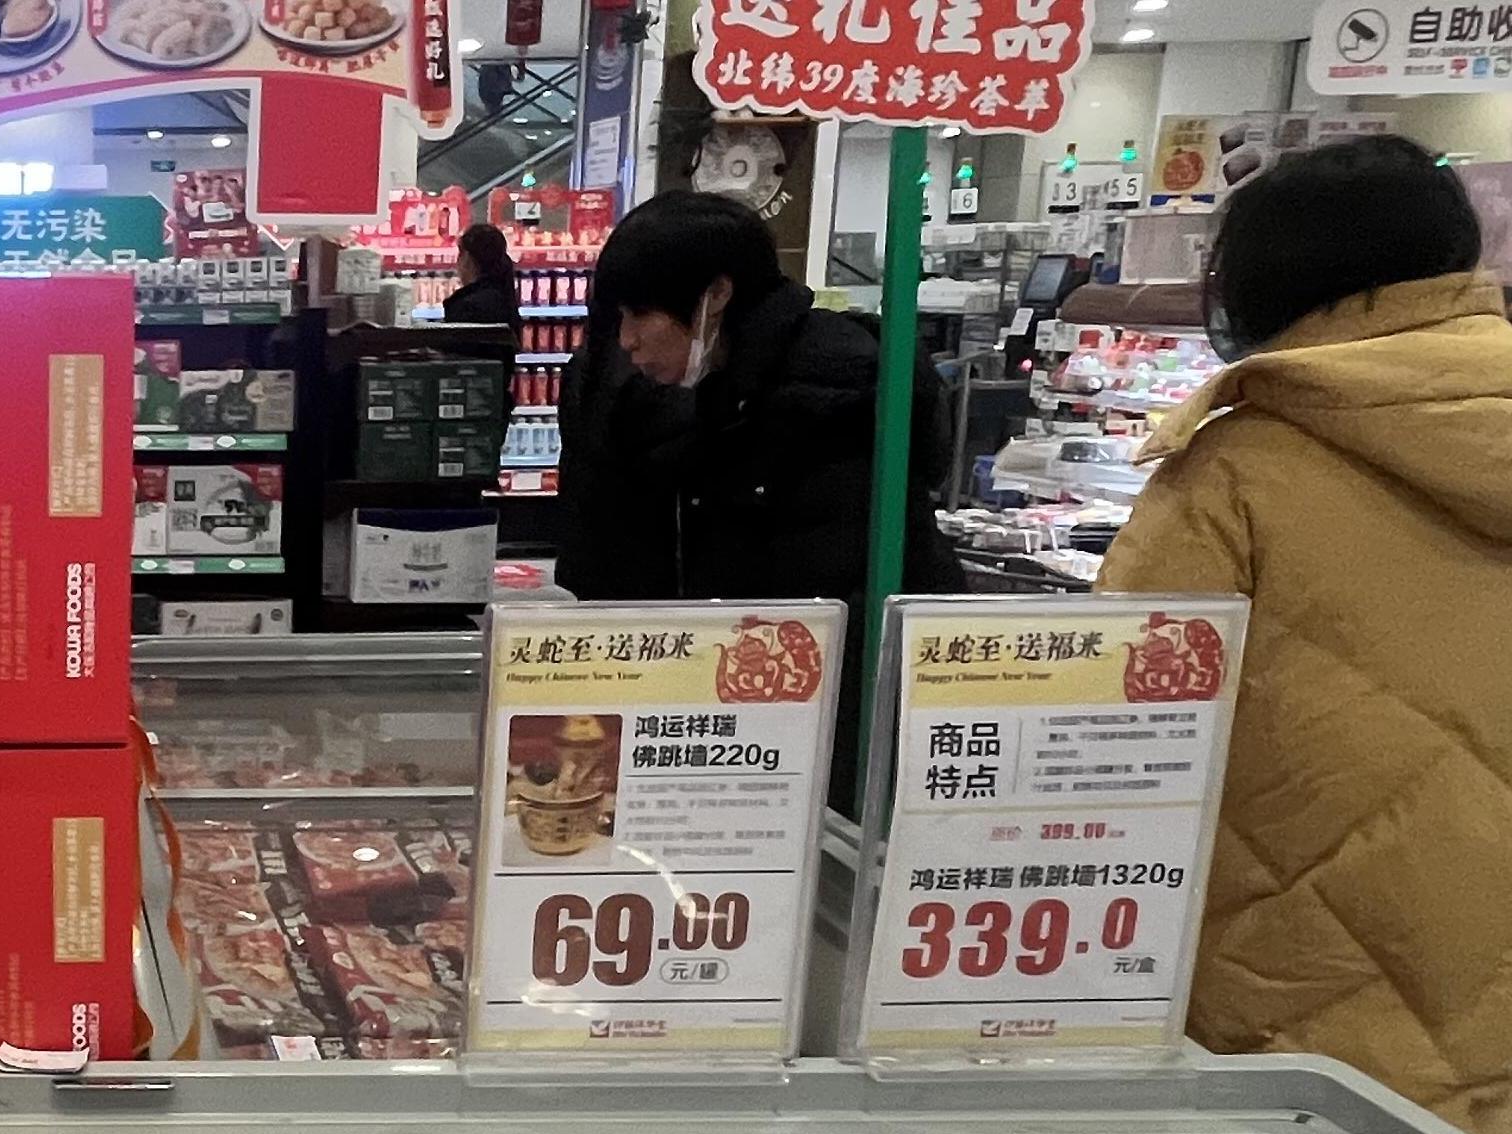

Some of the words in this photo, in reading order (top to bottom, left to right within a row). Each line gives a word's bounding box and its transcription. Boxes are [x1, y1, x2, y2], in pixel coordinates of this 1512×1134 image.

[718, 50, 1050, 120] 北纬39度海珍荟萃
[1, 208, 106, 242] 无污染
[67, 562, 82, 622] FOODS
[634, 714, 737, 739] 鸿运祥瑞
[929, 721, 1000, 758] 商品
[632, 743, 780, 770] 佛跳墙220g
[925, 763, 999, 800] 特点
[909, 867, 1014, 891] 鸿运祥瑞
[1020, 862, 1185, 889] 佛跳墙1320g
[532, 892, 750, 987] 69.00
[901, 896, 1139, 978] 339.0
[72, 1003, 88, 1051] OODS
